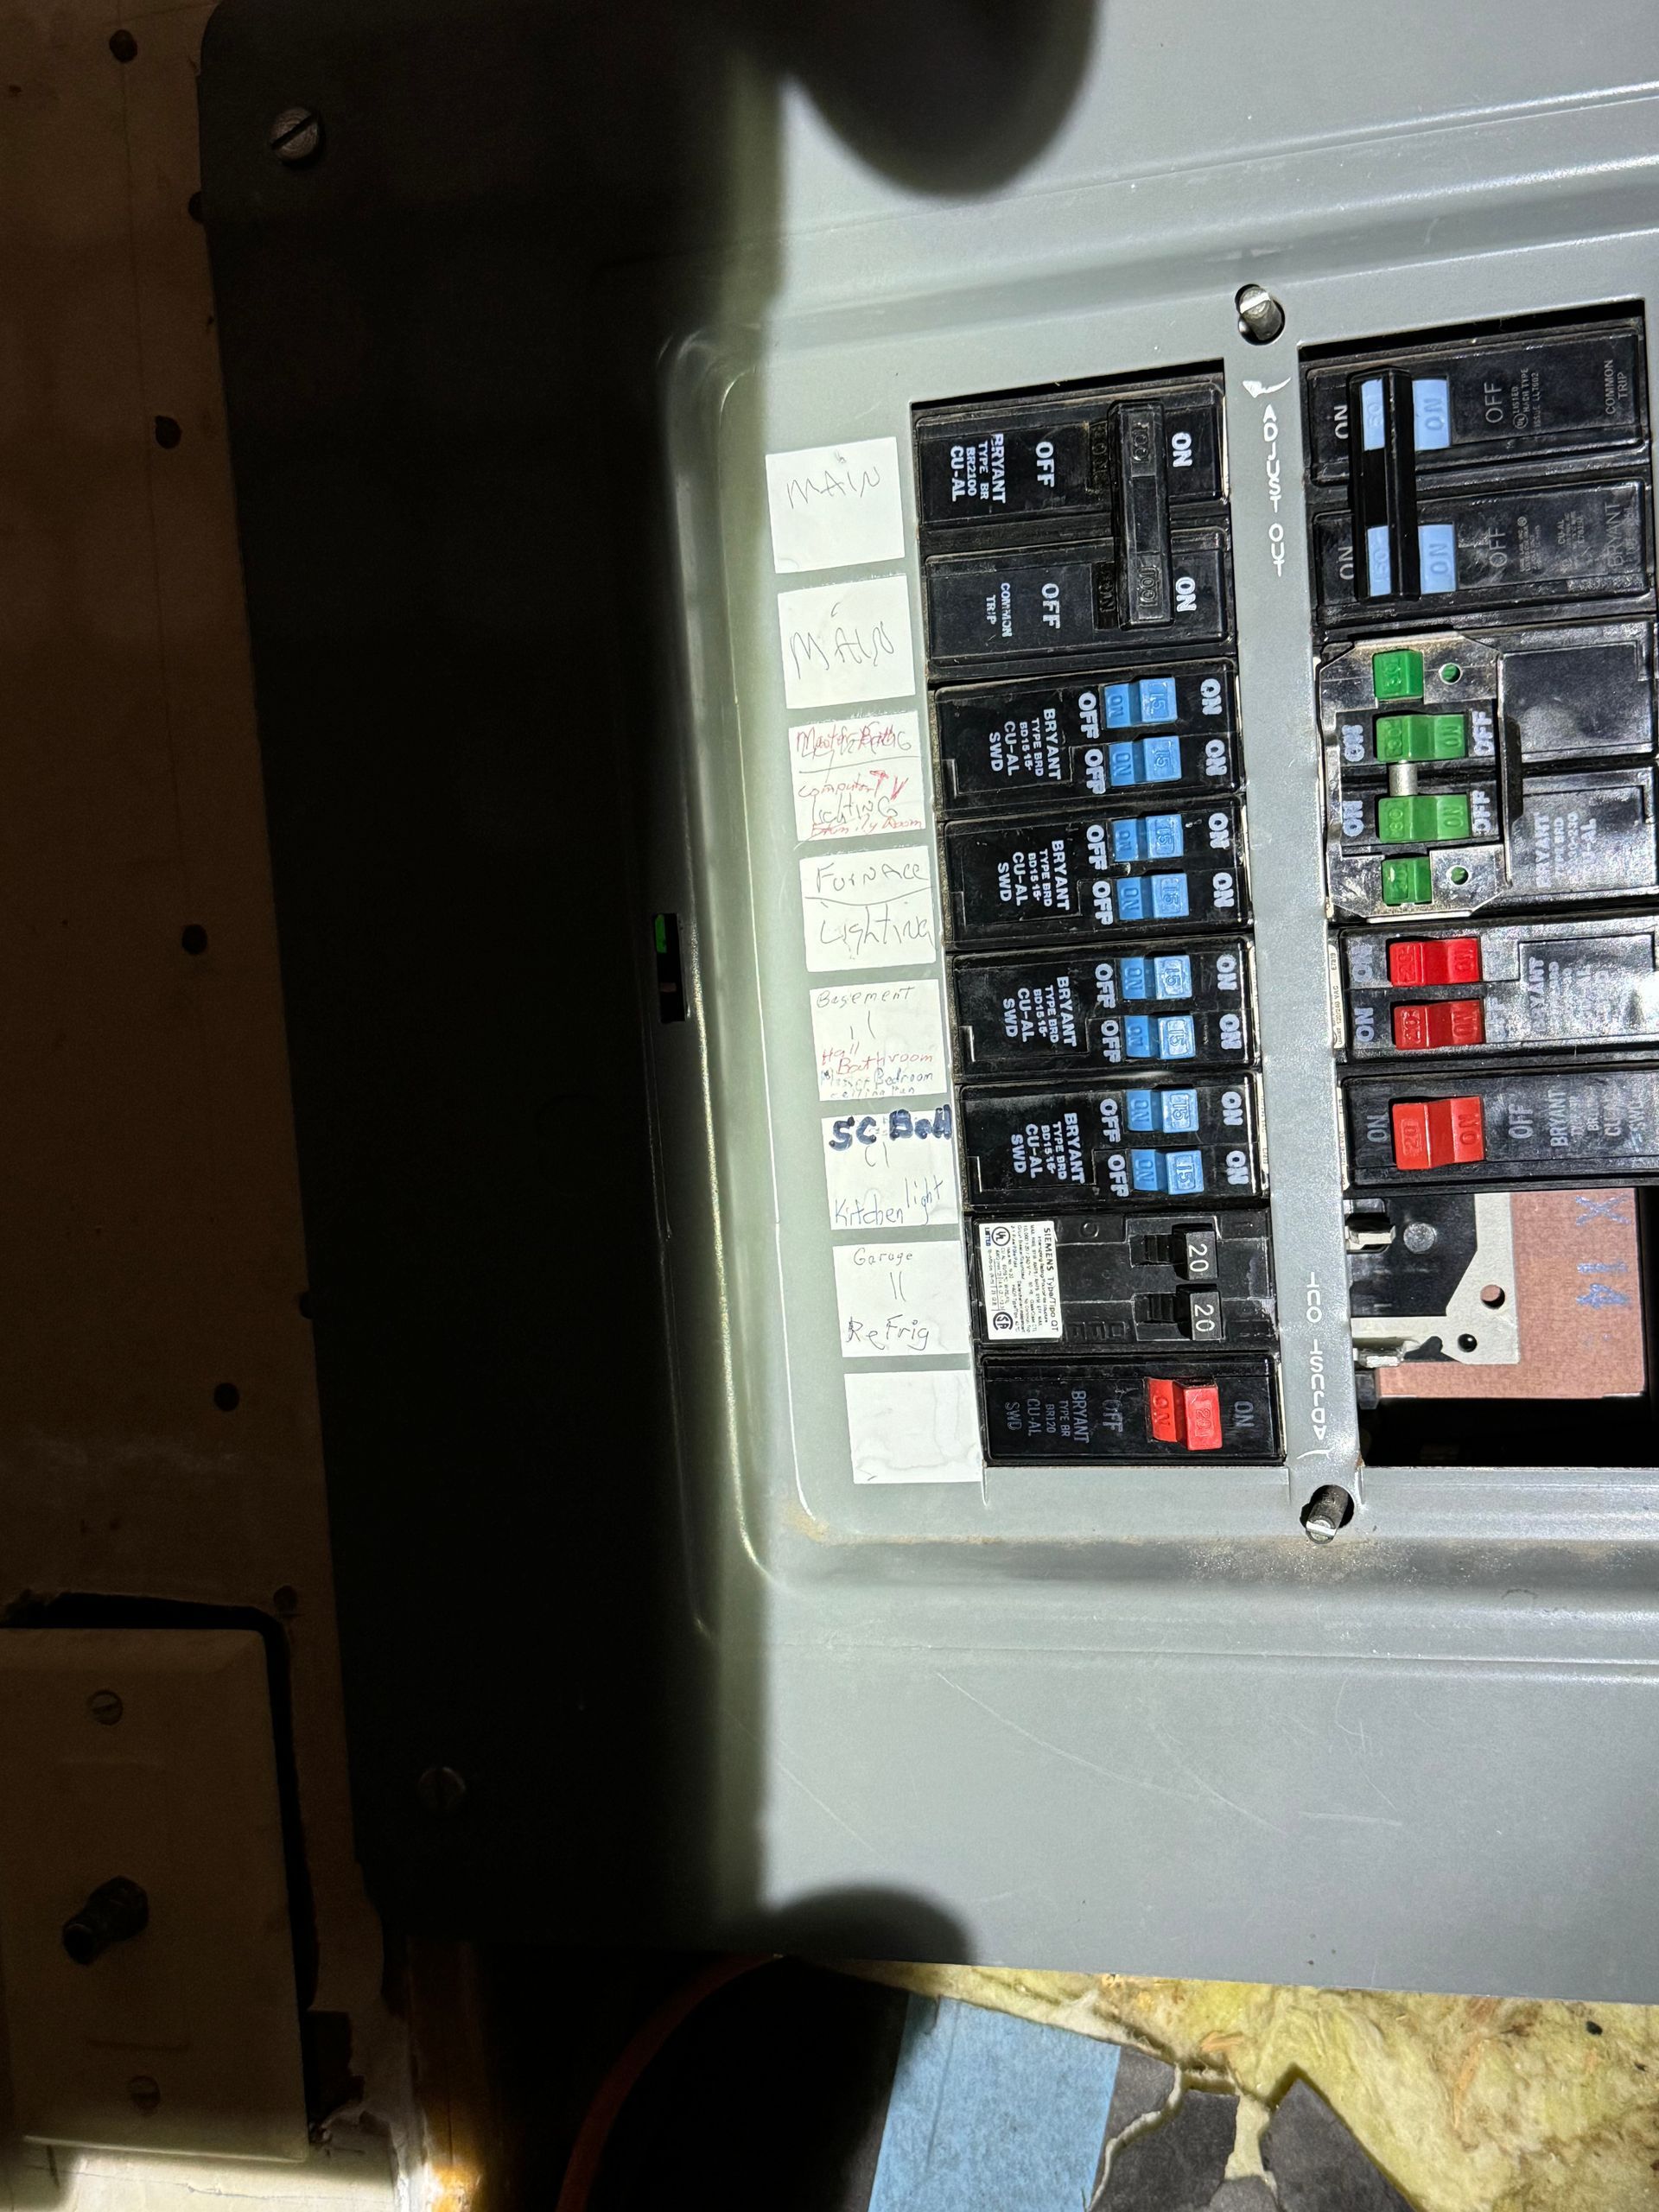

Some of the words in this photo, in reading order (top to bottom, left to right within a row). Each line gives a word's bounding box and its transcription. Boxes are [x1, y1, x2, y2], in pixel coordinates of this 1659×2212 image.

[1484, 382, 1503, 423] OFF
[1604, 359, 1616, 415] COMMON
[1617, 372, 1628, 400] TRIP
[1423, 398, 1444, 430] ON
[978, 439, 989, 474] TYPE
[1036, 441, 1055, 487] OFF
[1172, 432, 1192, 467] ON
[1263, 404, 1281, 512] ADJUST
[786, 467, 880, 509] MAIN
[950, 445, 966, 502] CU-AL
[966, 446, 977, 497] BR2100
[980, 482, 989, 499] BR
[1268, 523, 1285, 577] OUT
[1488, 527, 1507, 568] OFF
[1605, 502, 1624, 567] BRYANT
[1428, 543, 1448, 575] ON
[986, 594, 996, 625] TRIP
[1001, 582, 1013, 638] COMMON
[1041, 582, 1060, 629] OFF
[1176, 576, 1197, 613] ON
[790, 621, 894, 679] MAIN
[1078, 692, 1099, 739] OFF
[1200, 678, 1223, 715] ON
[989, 732, 1003, 772] SWD
[1004, 721, 1020, 776] CU-AL
[1031, 717, 1042, 750] TYPE
[1044, 708, 1061, 780] BRYANT
[1033, 752, 1044, 777] BRD
[1084, 748, 1106, 795] OFF
[1205, 739, 1228, 776] ON
[1208, 812, 1230, 849] ON
[1342, 800, 1365, 837] ON
[1444, 805, 1463, 828] ON
[1471, 790, 1491, 835] OFF
[1039, 849, 1051, 880] TYPE
[1086, 824, 1108, 870] OFF
[998, 862, 1012, 902] SWD
[1013, 851, 1028, 906] CU-AL
[1042, 882, 1052, 907] BRD
[1052, 840, 1070, 911] BRYANT
[1212, 872, 1235, 907] ON
[1092, 880, 1114, 925] OFF
[1095, 963, 1116, 1008] OFF
[1217, 954, 1238, 990] ON
[1003, 998, 1018, 1038] SWD
[1017, 988, 1034, 1042] CU-AL
[1045, 984, 1057, 1016] TYPE
[1057, 976, 1077, 1047] BRYANT
[1048, 1019, 1059, 1043] BRD
[1101, 1020, 1122, 1063] OFF
[1219, 1014, 1243, 1050] ON
[1354, 1007, 1375, 1042] ON
[1100, 1098, 1121, 1143] OFF
[1221, 1091, 1243, 1126] ON
[1509, 1103, 1534, 1139] OFF
[1548, 1089, 1568, 1147] BRYANT
[1052, 1121, 1065, 1153] TYPE
[1065, 1112, 1085, 1184] BRYANT
[1367, 1115, 1389, 1142] ON
[1011, 1134, 1027, 1173] SWD
[1026, 1123, 1043, 1179] CU-AL
[1056, 1155, 1067, 1180] BRD
[1225, 1150, 1249, 1185] ON
[1108, 1154, 1129, 1198] OFF
[836, 1194, 904, 1226] Kitchen
[1043, 1227, 1053, 1271] SIEMENS
[1188, 1243, 1209, 1273] 20
[1046, 1276, 1057, 1317] Type/Tipo
[1306, 1271, 1322, 1323] OUT
[1051, 1319, 1058, 1332] QT
[1194, 1304, 1215, 1332] 20
[1310, 1339, 1326, 1440] ADJUST
[1005, 1402, 1022, 1431] SWD
[1046, 1403, 1056, 1433] BR120
[1058, 1400, 1069, 1421] TYPE
[1071, 1390, 1090, 1443] BRYANT
[1103, 1400, 1123, 1433] OFF
[1234, 1401, 1255, 1427] ON
[1060, 1425, 1071, 1438] BR
